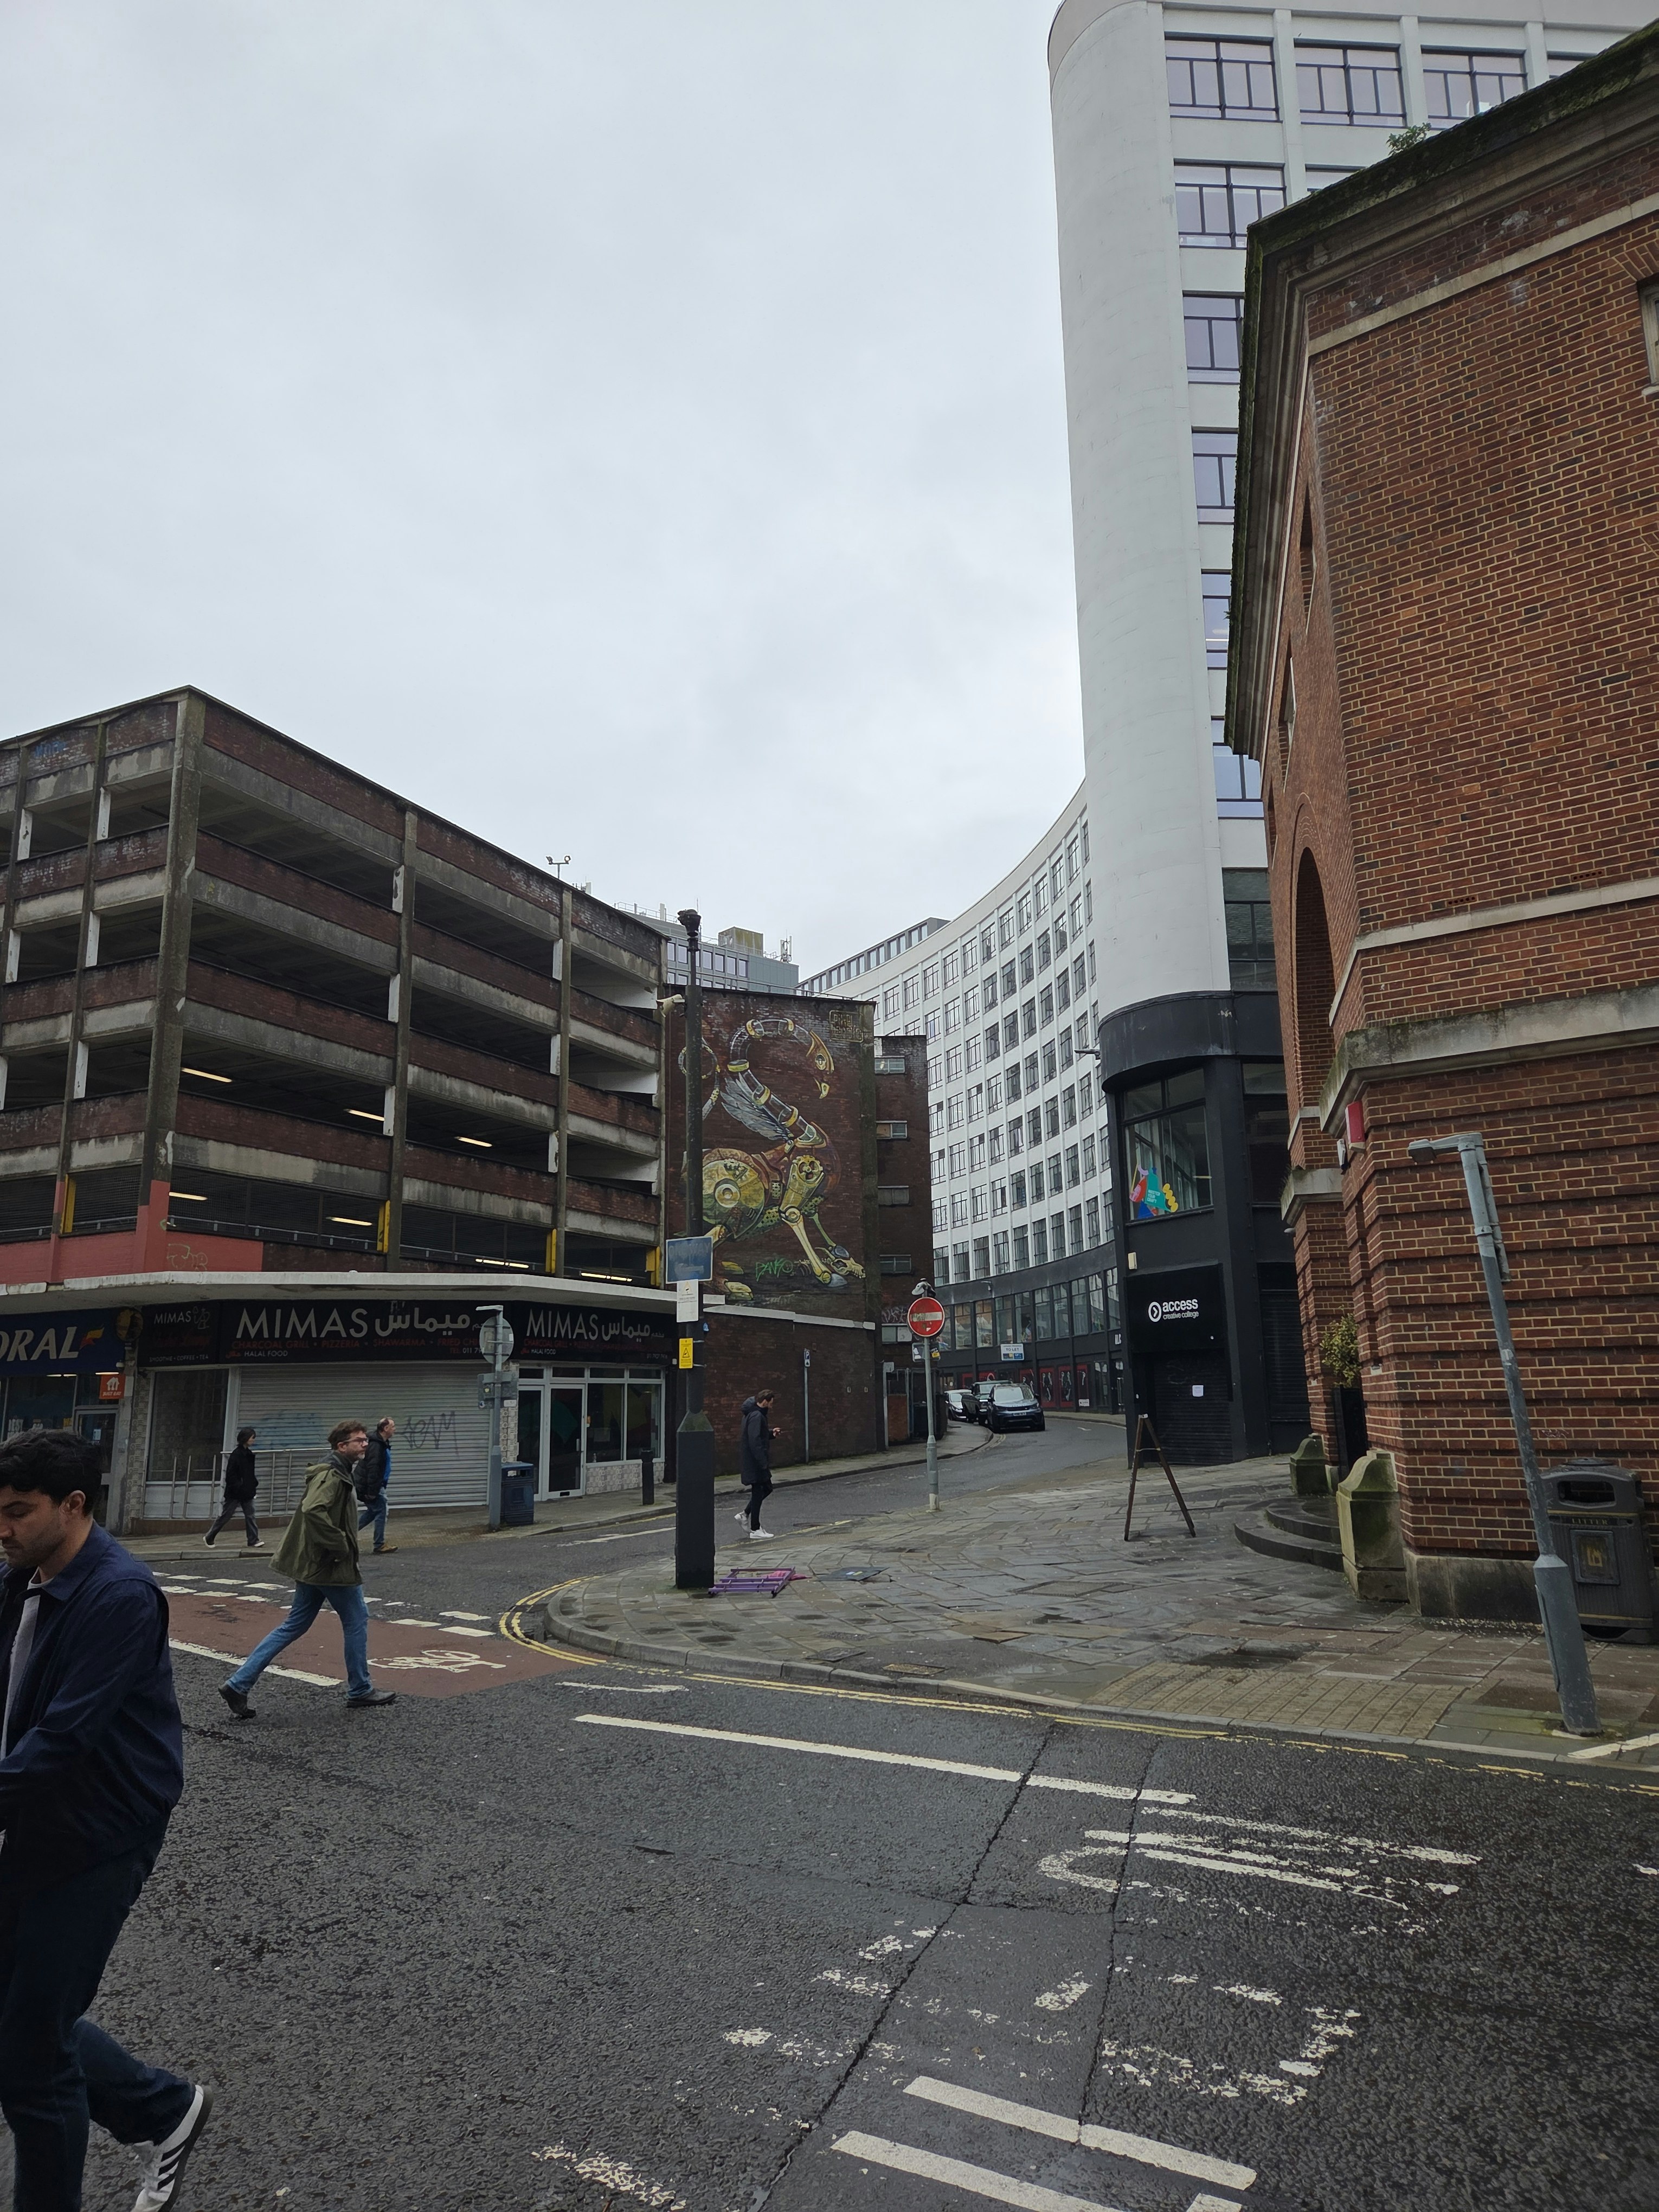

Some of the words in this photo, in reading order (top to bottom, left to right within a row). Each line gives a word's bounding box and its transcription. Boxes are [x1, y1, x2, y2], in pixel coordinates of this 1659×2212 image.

[1162, 1298, 1199, 1313] access
[154, 1310, 191, 1324] MIMAS
[375, 1307, 471, 1337] ميماس
[1163, 1312, 1181, 1320] creative
[1181, 1310, 1199, 1319] college
[236, 1307, 368, 1339] MIMAS
[526, 1308, 599, 1341] MIMAS
[601, 1316, 651, 1342] ميماس
[232, 1340, 282, 1349] CHARCOAL
[286, 1340, 310, 1349] GRILL
[321, 1340, 360, 1348] PIZZERIA
[372, 1338, 426, 1347] SHAWARMA
[437, 1338, 461, 1346] FRIED
[1571, 1517, 1609, 1526] LITTER
